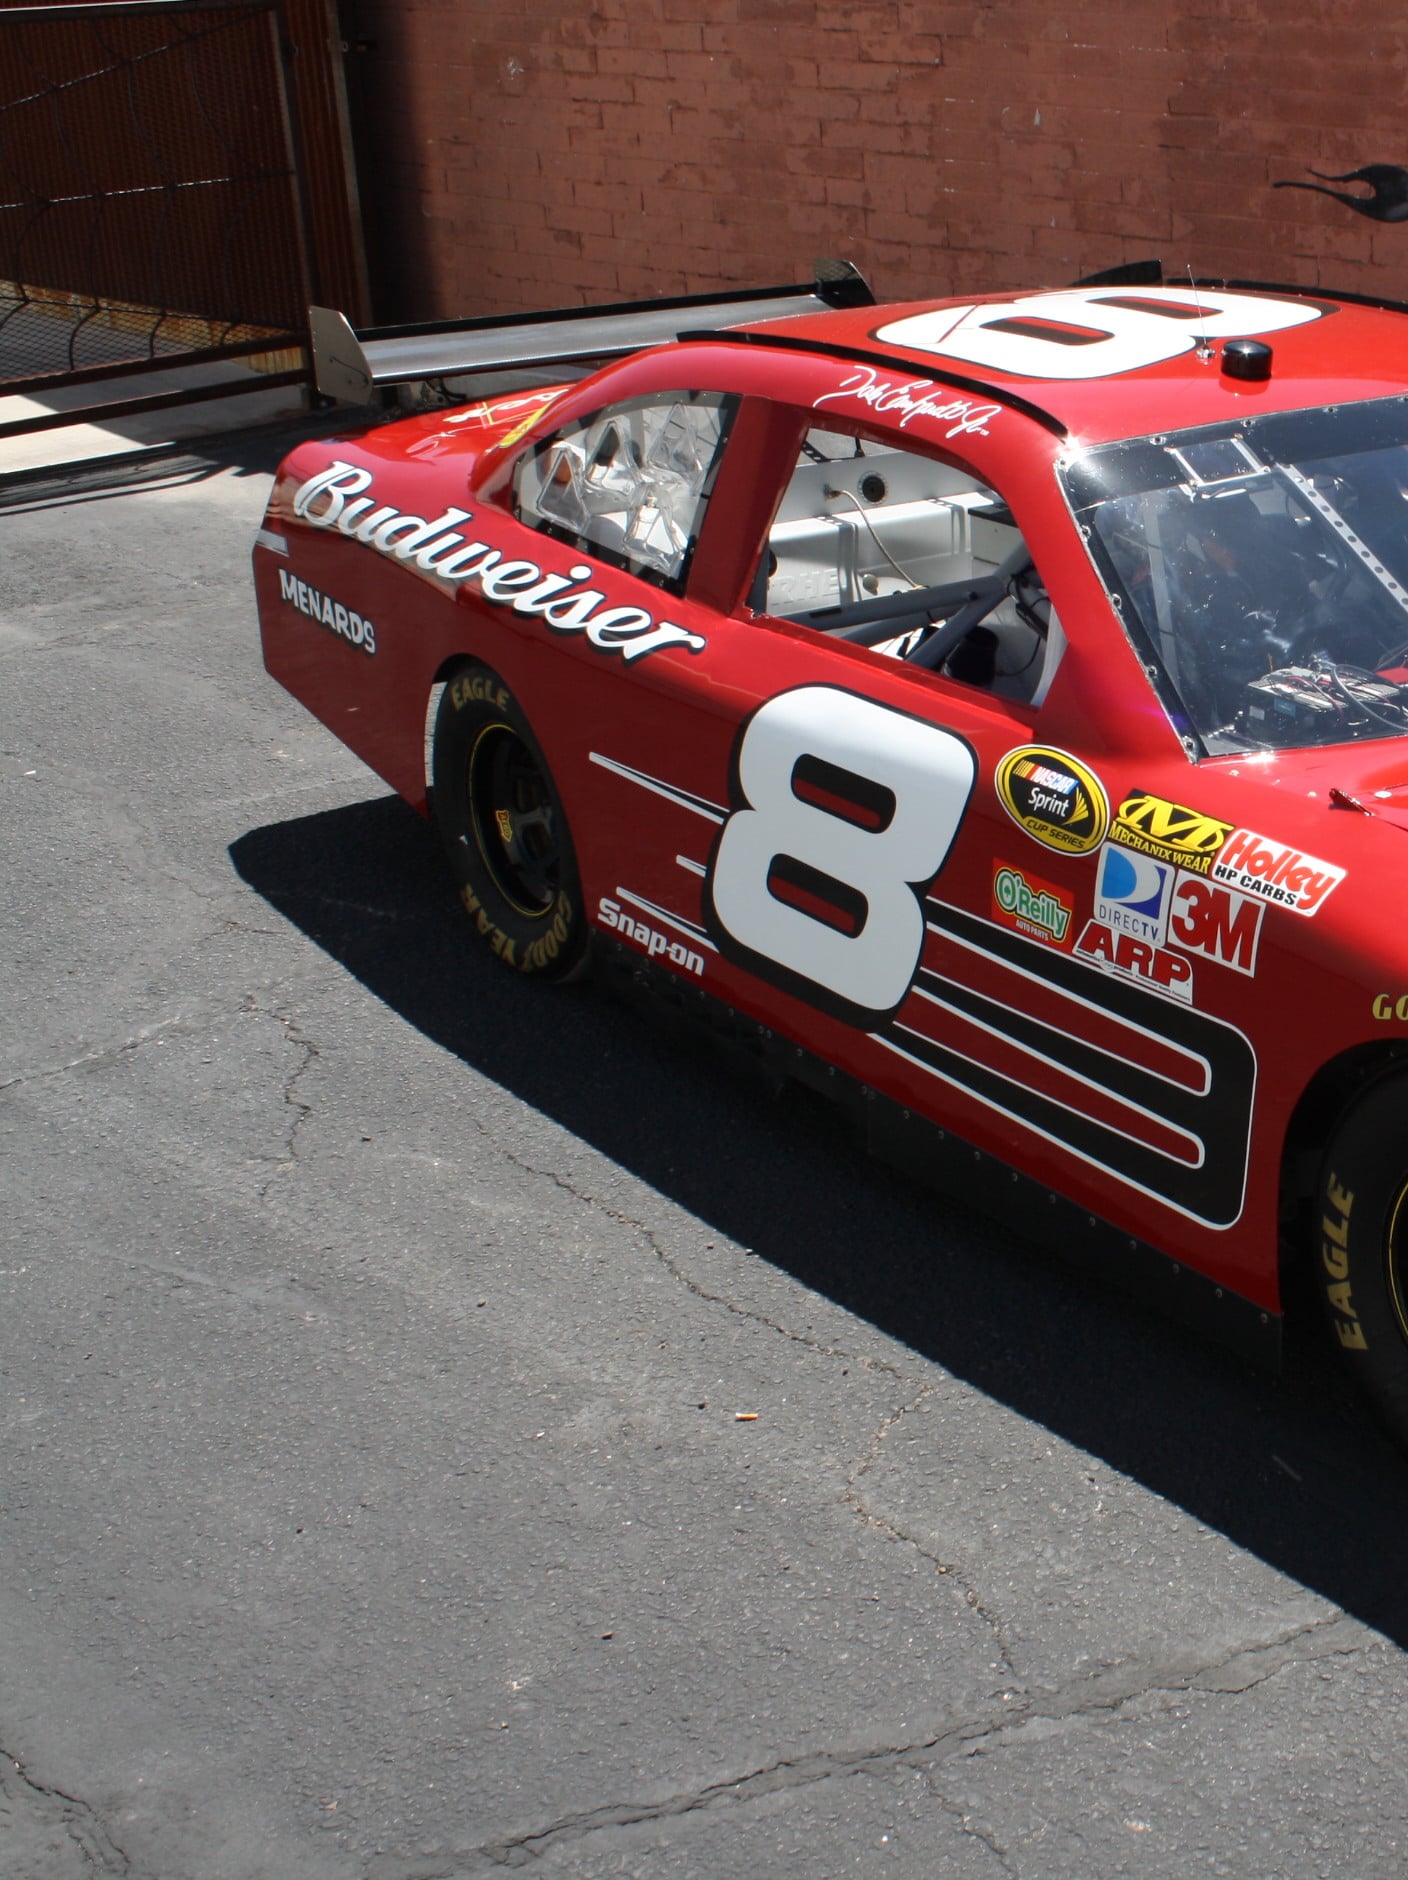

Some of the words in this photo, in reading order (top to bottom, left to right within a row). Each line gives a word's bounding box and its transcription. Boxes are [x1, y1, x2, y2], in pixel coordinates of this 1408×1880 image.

[872, 286, 1326, 380] 8
[293, 460, 707, 660] Budweiser
[279, 568, 376, 654] MENARDS
[451, 676, 510, 712] EAGLE
[1028, 787, 1070, 817] Sprint
[1029, 766, 1079, 795] NASCAR
[711, 685, 976, 1012] 8
[1026, 820, 1049, 833] CUP
[1049, 829, 1086, 849] SERIES
[1108, 821, 1173, 863] MECHANIX
[1172, 853, 1212, 875] WEAR
[997, 871, 1068, 934] O'Reilly
[1214, 865, 1238, 881] HP
[1240, 875, 1298, 905] CARBS
[1219, 831, 1338, 910] Holley
[598, 897, 705, 976] Snap-on
[1016, 919, 1031, 933] AUTO
[1030, 926, 1049, 941] PARTS
[1077, 920, 1191, 988] ARP
[1099, 904, 1160, 942] DIRECTV
[1172, 879, 1255, 971] 3M
[1322, 1171, 1369, 1350] EAGLE
